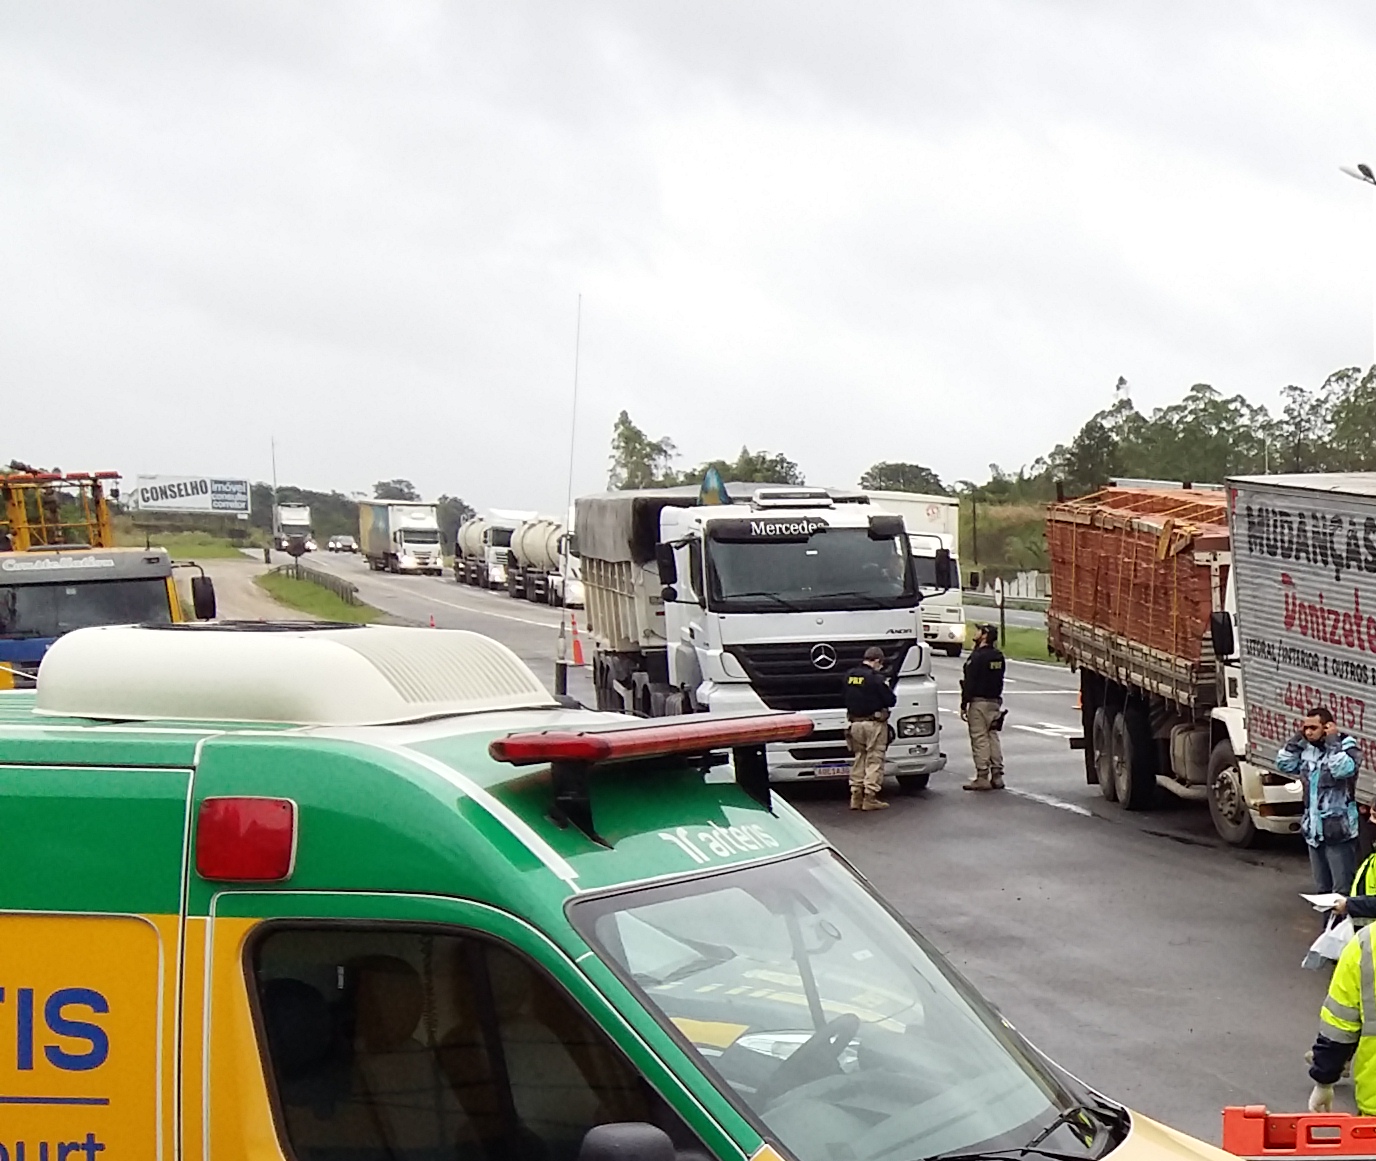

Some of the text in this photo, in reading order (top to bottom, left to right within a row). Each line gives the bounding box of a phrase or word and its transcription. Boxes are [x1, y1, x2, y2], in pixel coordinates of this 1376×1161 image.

[140, 479, 209, 503] CONSELHO
[1331, 658, 1369, 685] OUTROS
[0, 986, 110, 1071] IS
